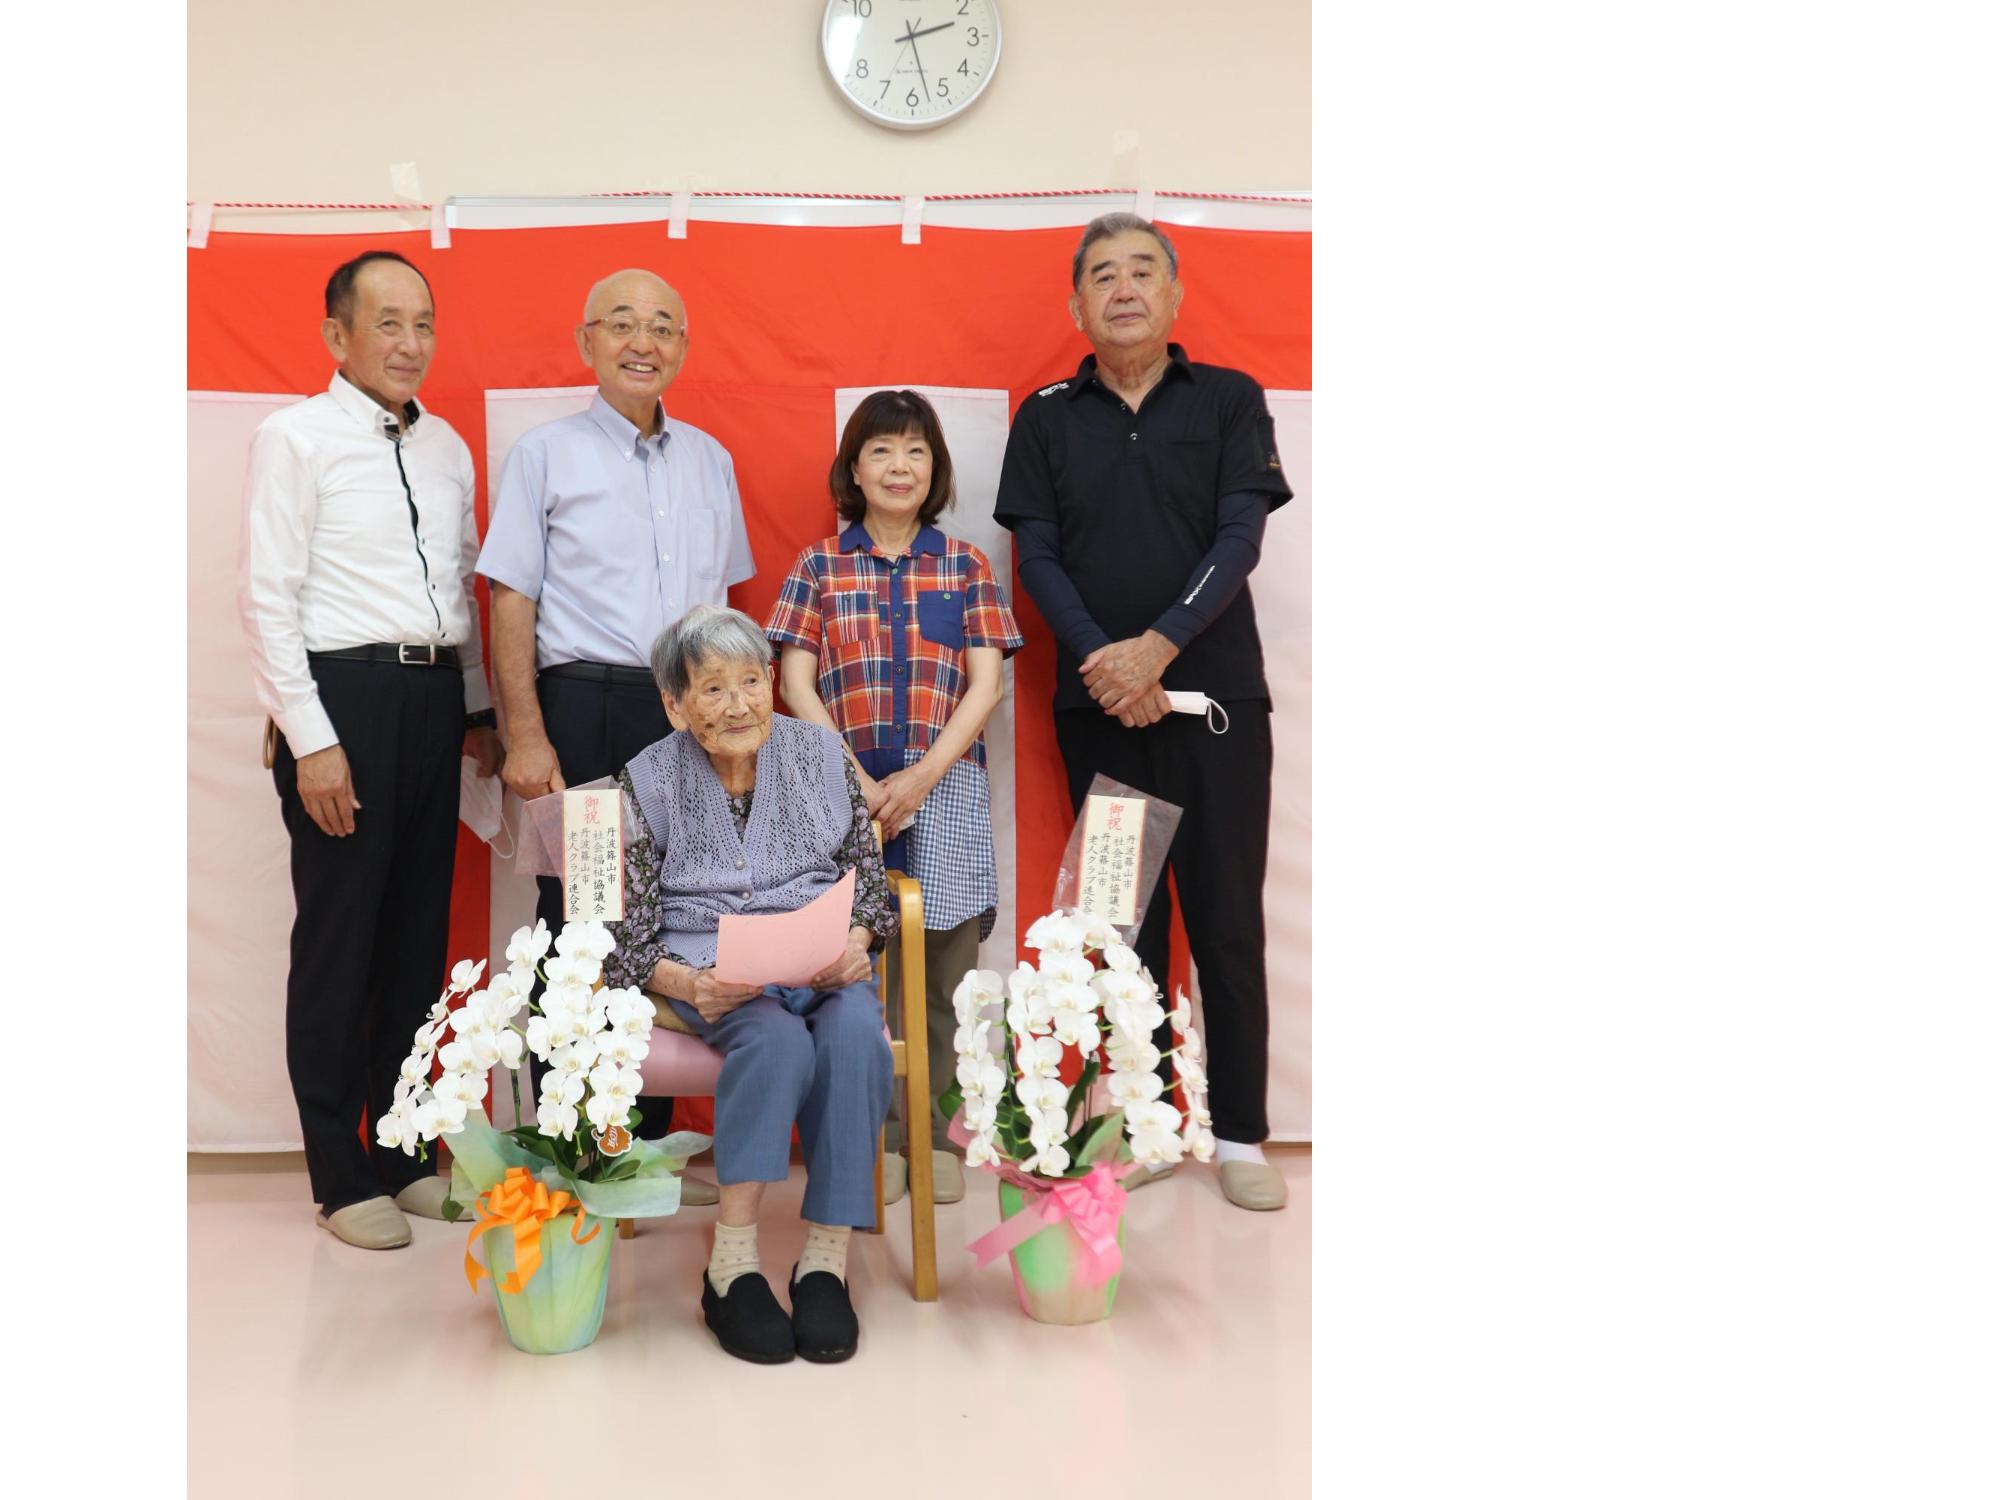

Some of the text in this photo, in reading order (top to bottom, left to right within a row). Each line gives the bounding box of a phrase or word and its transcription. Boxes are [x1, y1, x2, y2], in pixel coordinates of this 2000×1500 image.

[853, 0, 872, 18] 10
[957, 0, 969, 15] 2
[967, 27, 980, 47] 3
[855, 59, 869, 78] 8
[957, 59, 969, 77] 4
[880, 80, 891, 99] 7
[937, 78, 949, 97] 5
[905, 88, 919, 107] 6
[584, 795, 600, 824] 御祝
[1107, 802, 1125, 831] 御祝
[606, 826, 617, 885] 丹波篠山市
[568, 831, 580, 915] 老人クラブ連合会
[593, 829, 606, 915] 社会福祉協議会
[1108, 836, 1124, 918] 社会福祉協議会
